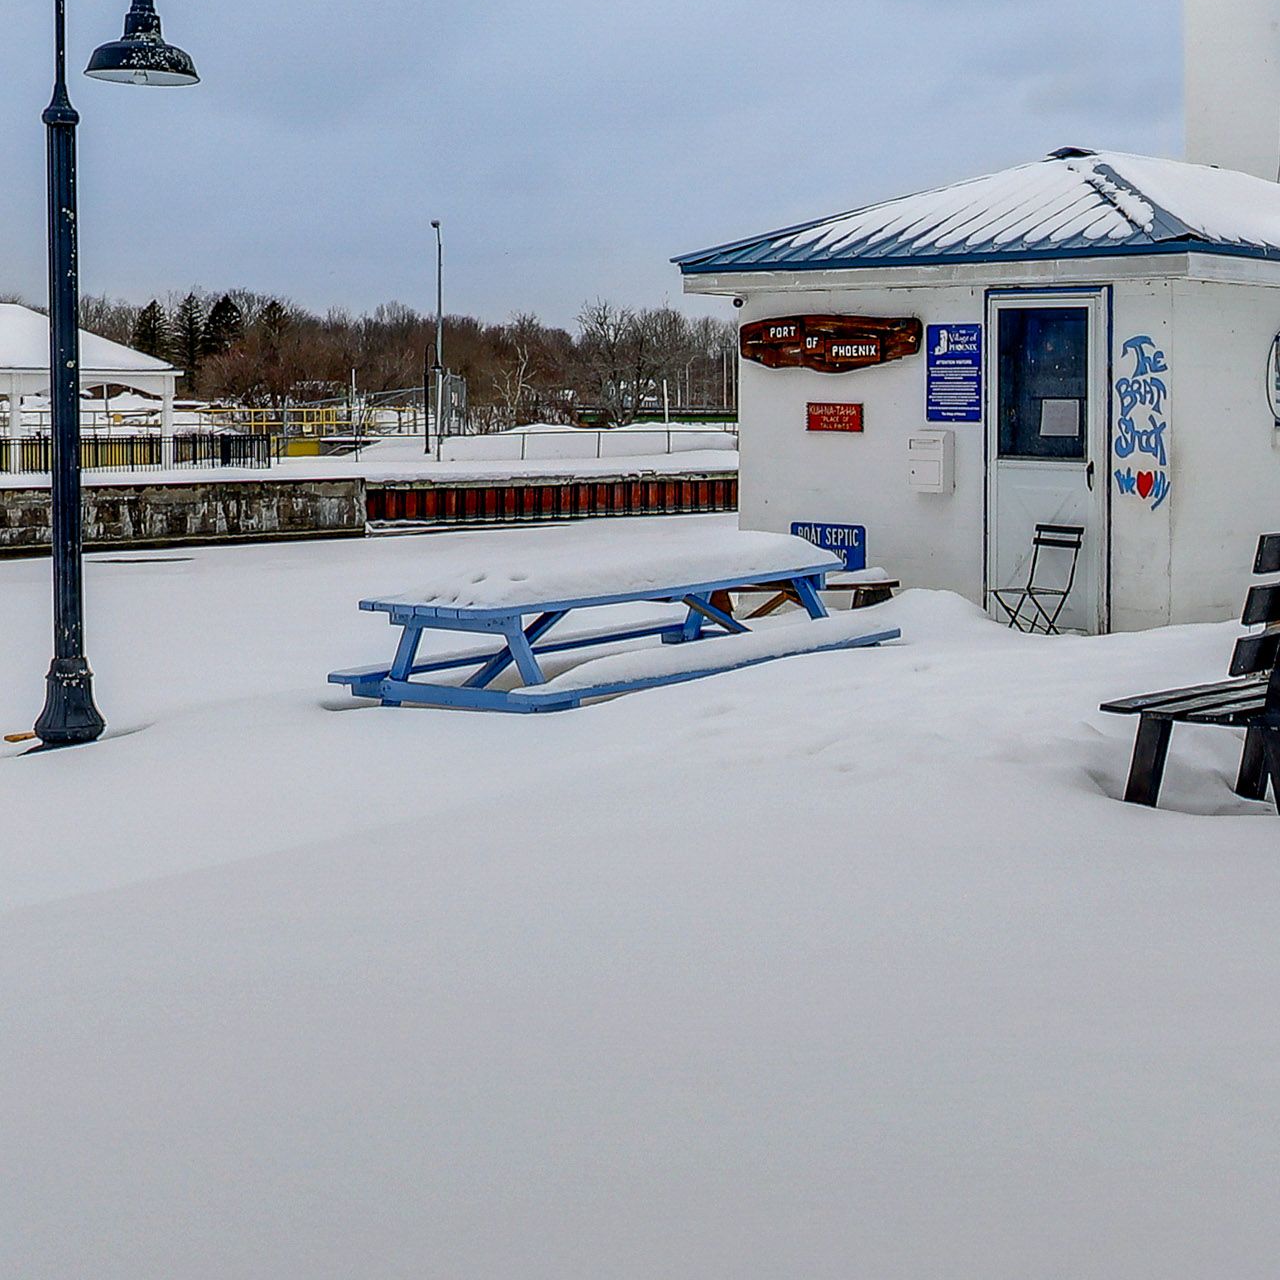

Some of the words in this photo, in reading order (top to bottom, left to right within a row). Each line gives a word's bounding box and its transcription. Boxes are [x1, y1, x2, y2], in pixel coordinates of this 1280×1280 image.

[769, 326, 797, 339] PORT
[805, 337, 819, 349] OF
[831, 345, 877, 357] PHOENIX
[1115, 376, 1167, 417] BRAT
[1115, 414, 1167, 466] Shack
[825, 527, 859, 547] SEPTIC
